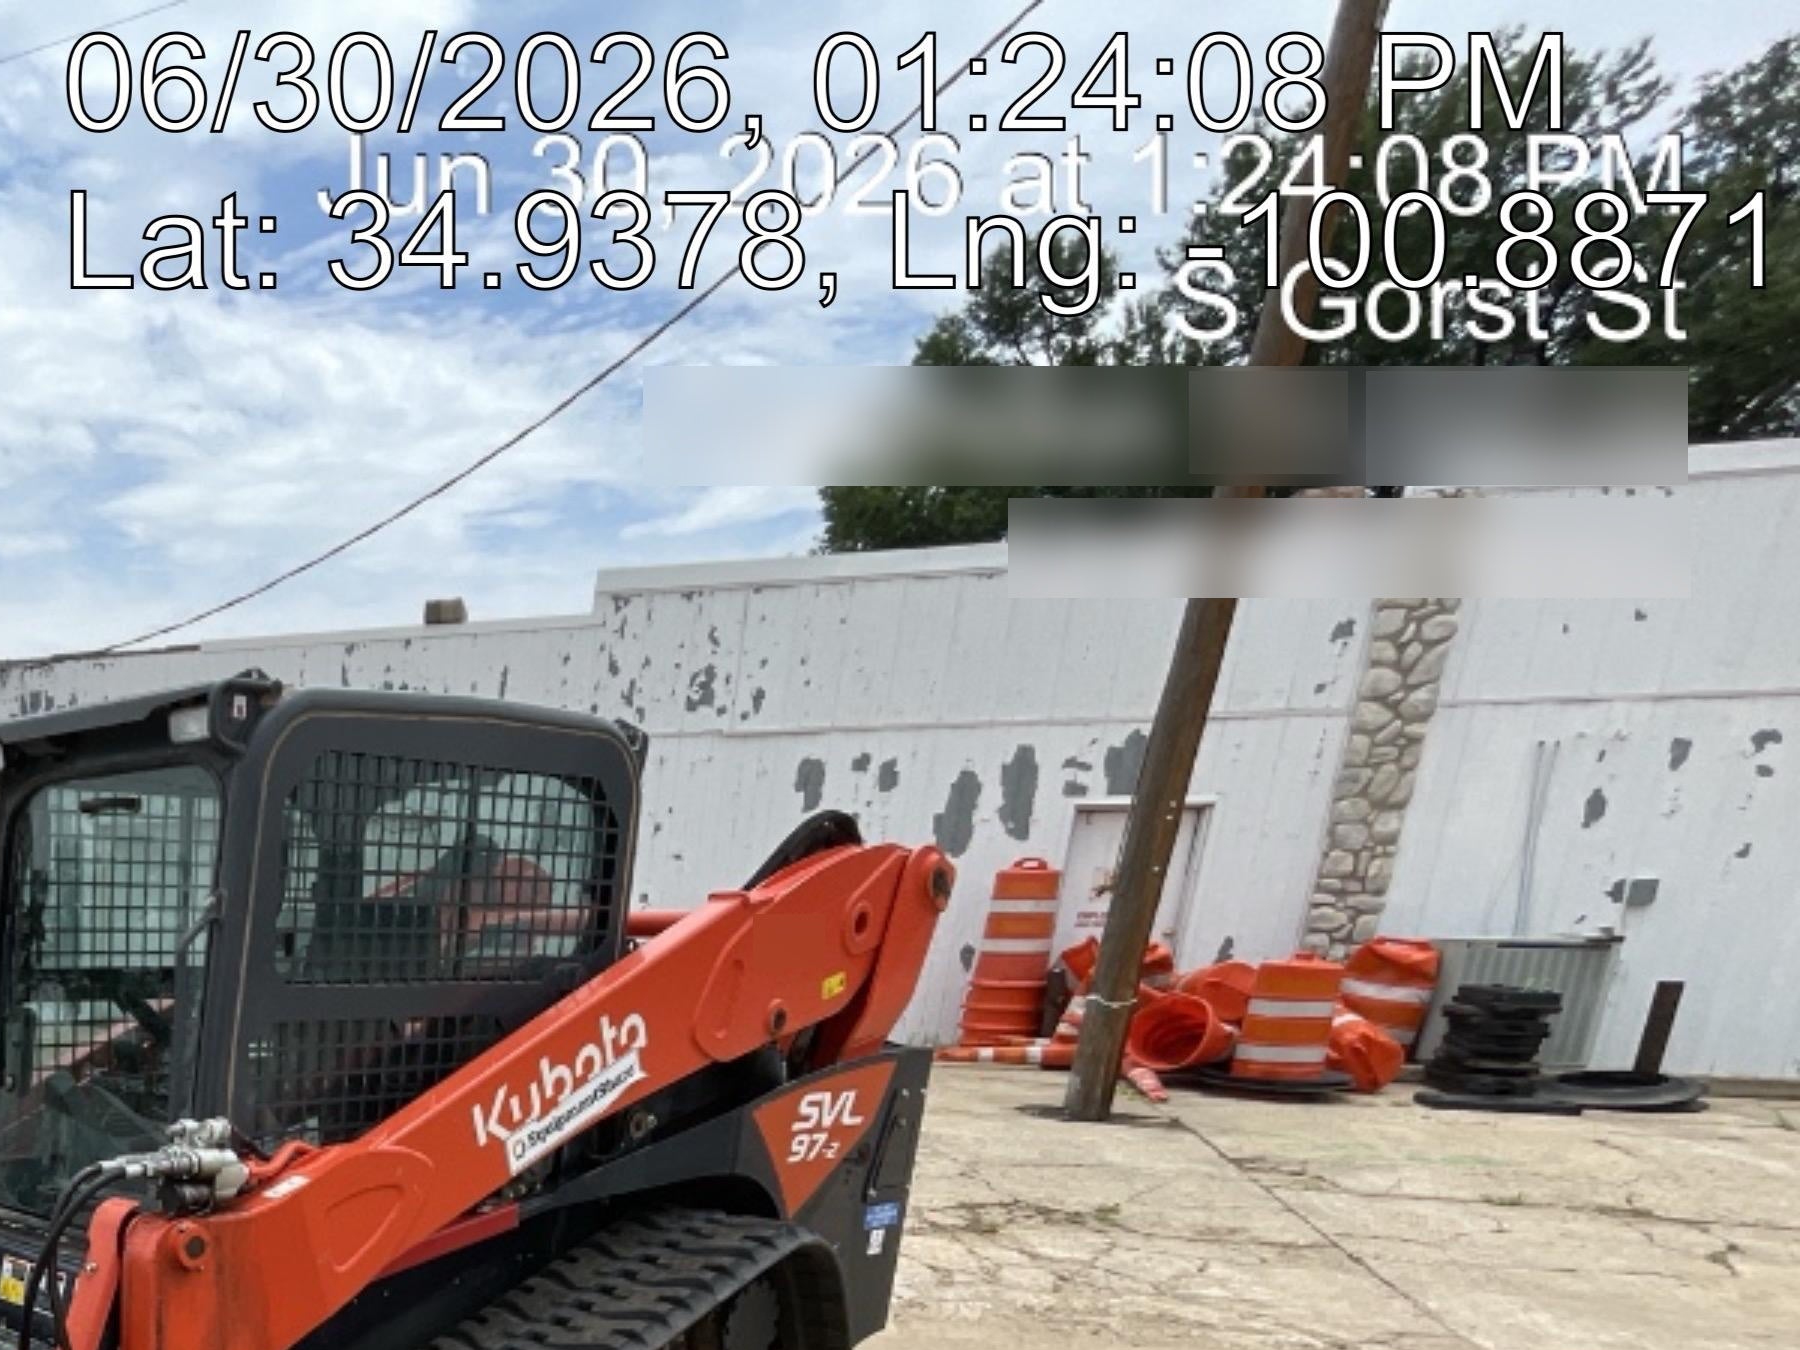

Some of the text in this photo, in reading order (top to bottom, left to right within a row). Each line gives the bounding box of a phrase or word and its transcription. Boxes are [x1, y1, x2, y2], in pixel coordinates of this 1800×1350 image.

[472, 1012, 648, 1148] Kubota
[791, 1088, 865, 1132] SVL
[786, 1131, 841, 1165] 97-2
